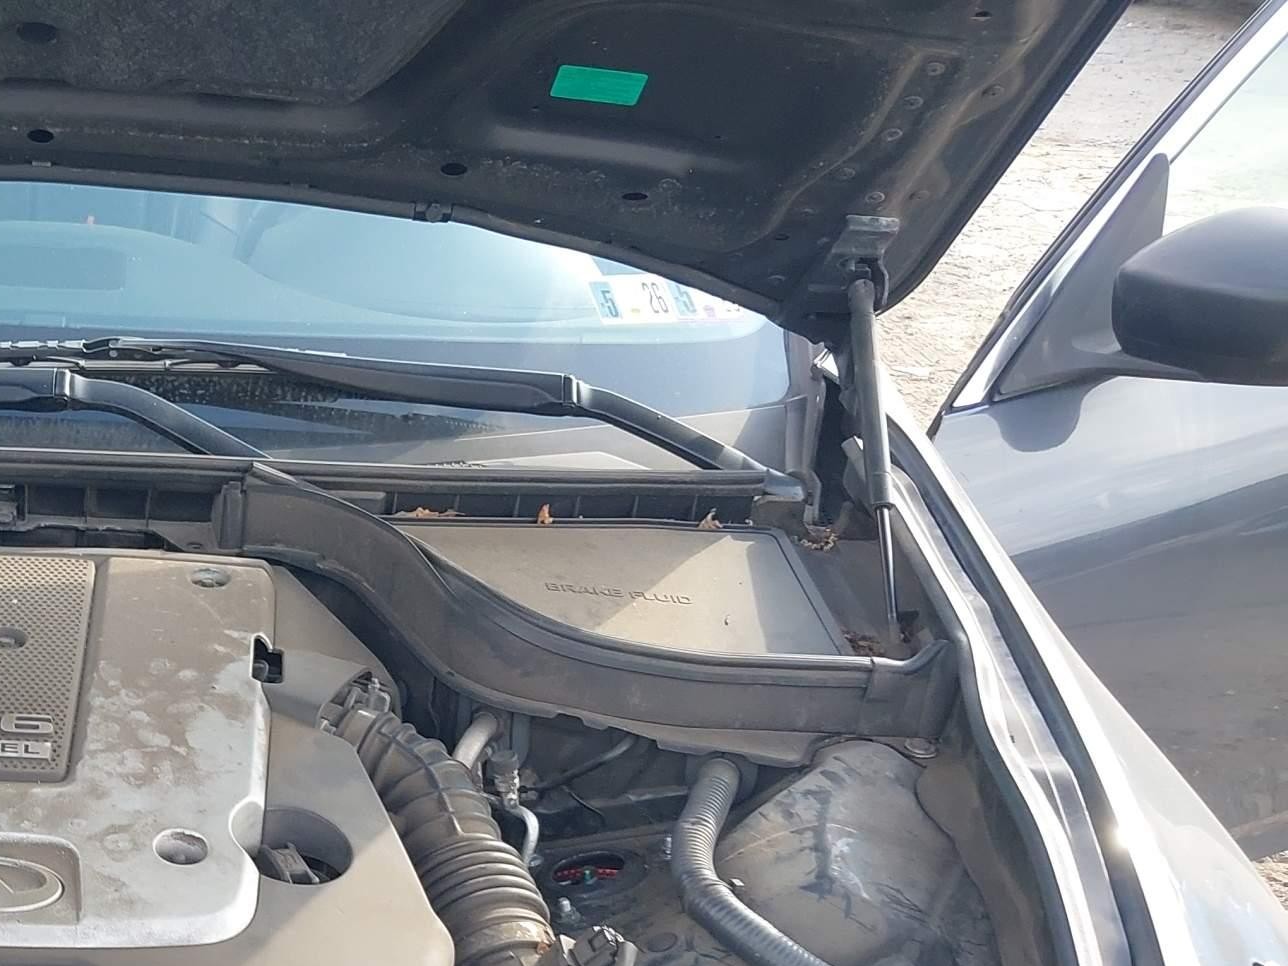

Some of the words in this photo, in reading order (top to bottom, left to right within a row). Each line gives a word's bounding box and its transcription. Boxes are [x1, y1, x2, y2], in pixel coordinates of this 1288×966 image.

[640, 281, 669, 314] 26
[544, 582, 625, 598] BRAKE
[627, 590, 693, 605] FLUID
